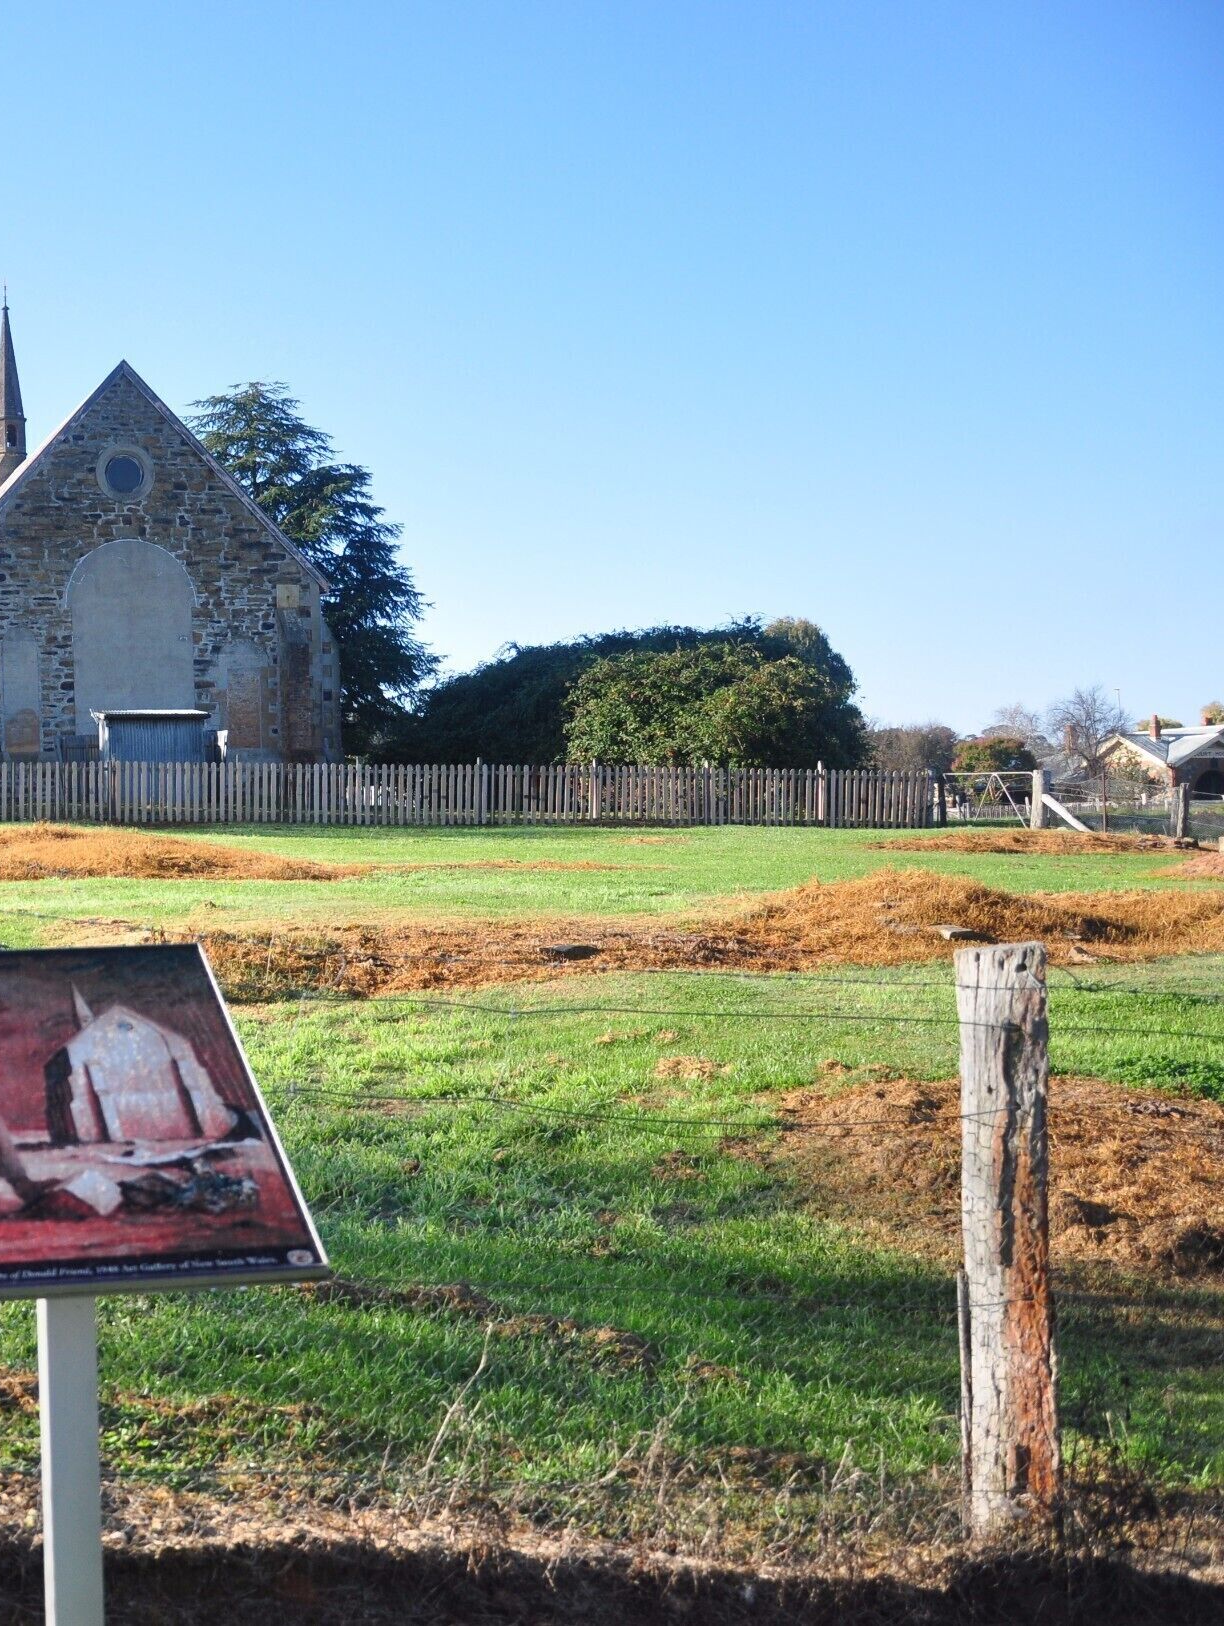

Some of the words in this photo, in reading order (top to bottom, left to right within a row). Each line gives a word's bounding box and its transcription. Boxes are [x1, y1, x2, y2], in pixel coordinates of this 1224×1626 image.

[9, 1270, 20, 1279] of
[22, 1268, 56, 1278] Donald
[140, 1262, 176, 1271] Gallery
[179, 1260, 189, 1268] of
[215, 1257, 244, 1266] South
